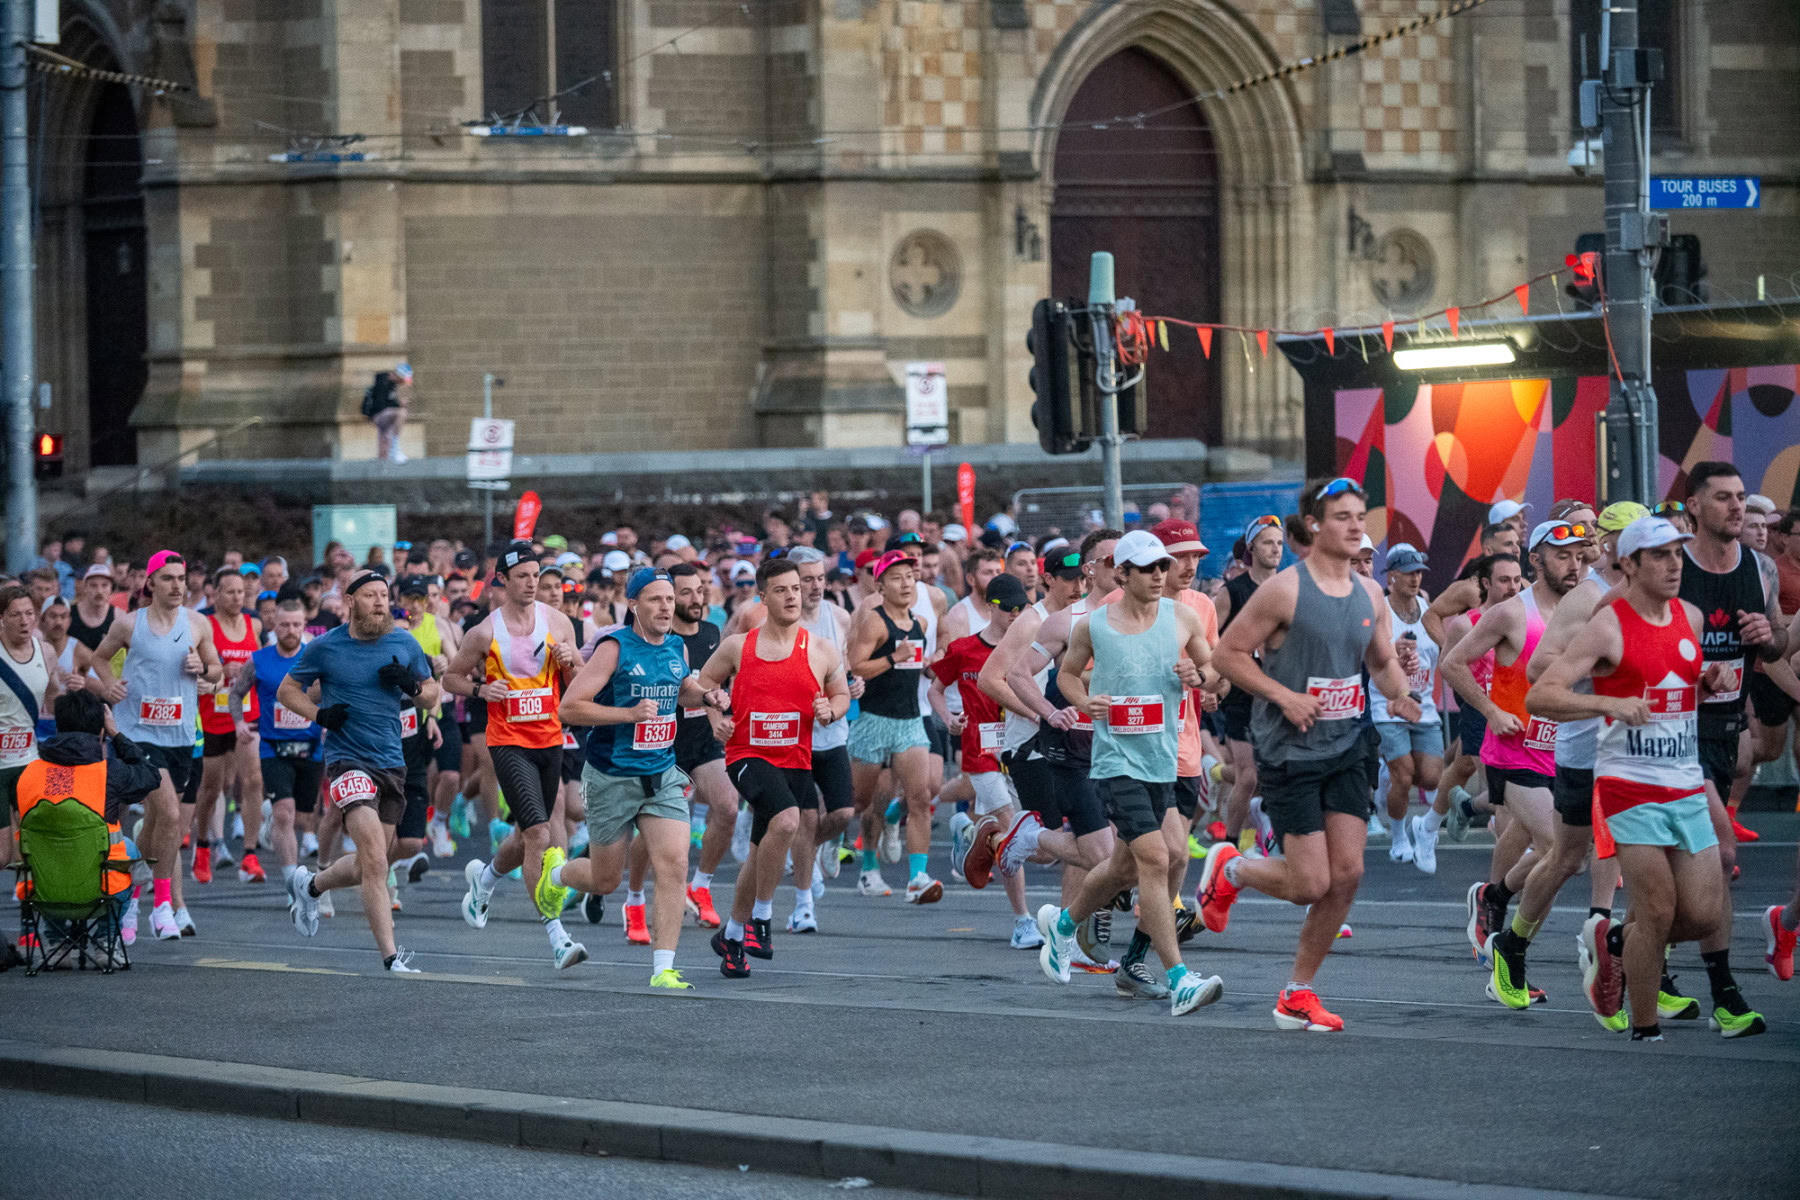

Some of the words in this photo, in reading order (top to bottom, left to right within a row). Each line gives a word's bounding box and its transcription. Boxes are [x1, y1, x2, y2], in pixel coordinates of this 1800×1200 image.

[1661, 180, 1693, 193] TOUR
[1698, 180, 1737, 193] BUSES
[1682, 194, 1702, 207] 200
[1706, 196, 1717, 207] m
[630, 683, 680, 698] Emirate
[148, 704, 176, 719] 7382
[519, 697, 542, 714] 509
[1128, 706, 1143, 716] NICK
[763, 722, 789, 730] CAMERON
[1128, 716, 1144, 725] 3277
[644, 724, 671, 741] 5331
[769, 730, 783, 738] 3414
[1, 733, 28, 749] 6756
[338, 777, 370, 799] 6450
